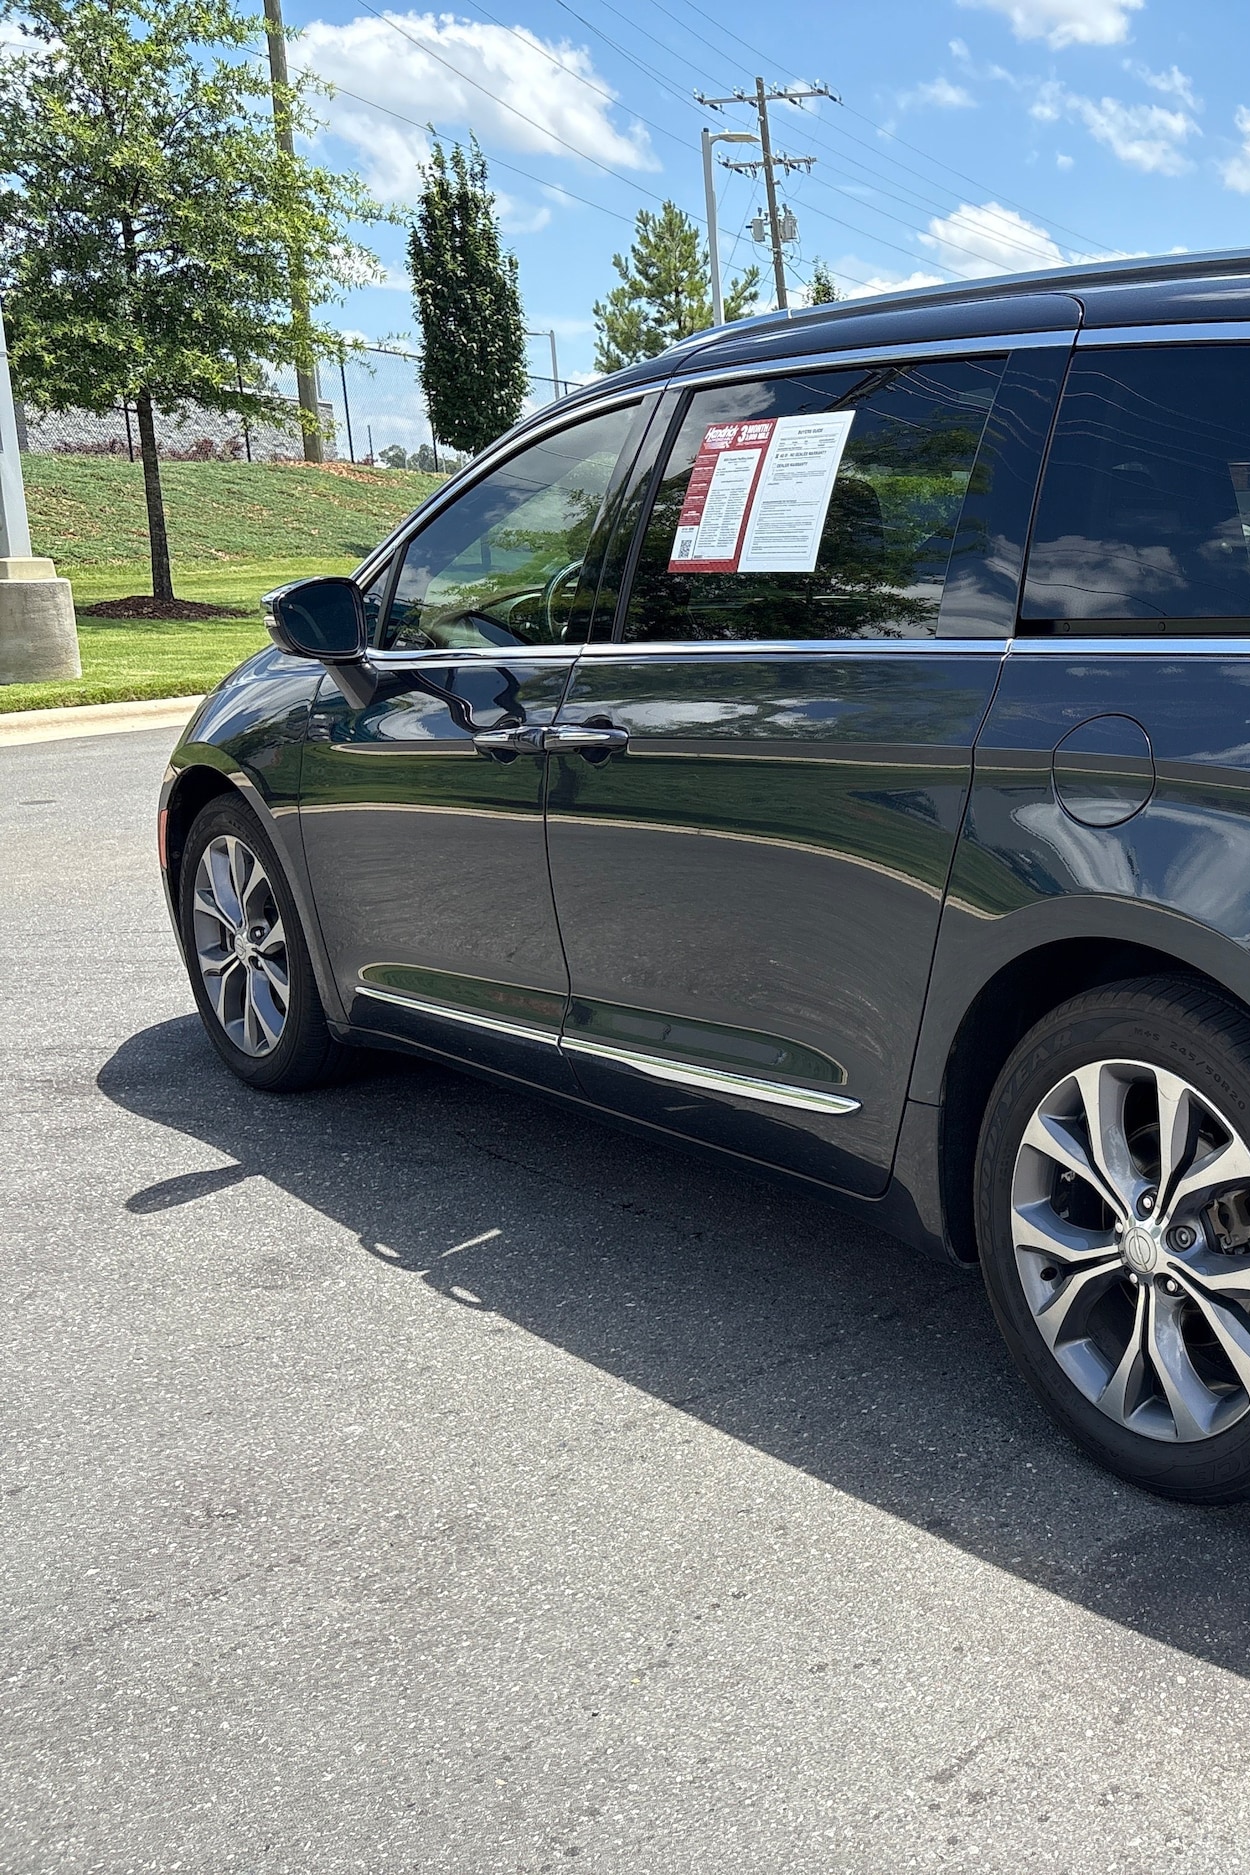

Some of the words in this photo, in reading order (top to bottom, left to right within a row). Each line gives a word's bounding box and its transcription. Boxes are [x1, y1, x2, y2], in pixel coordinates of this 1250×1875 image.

[704, 424, 739, 442] Hendrick
[737, 425, 749, 443] 3
[1169, 1040, 1247, 1111] 245/50R20
